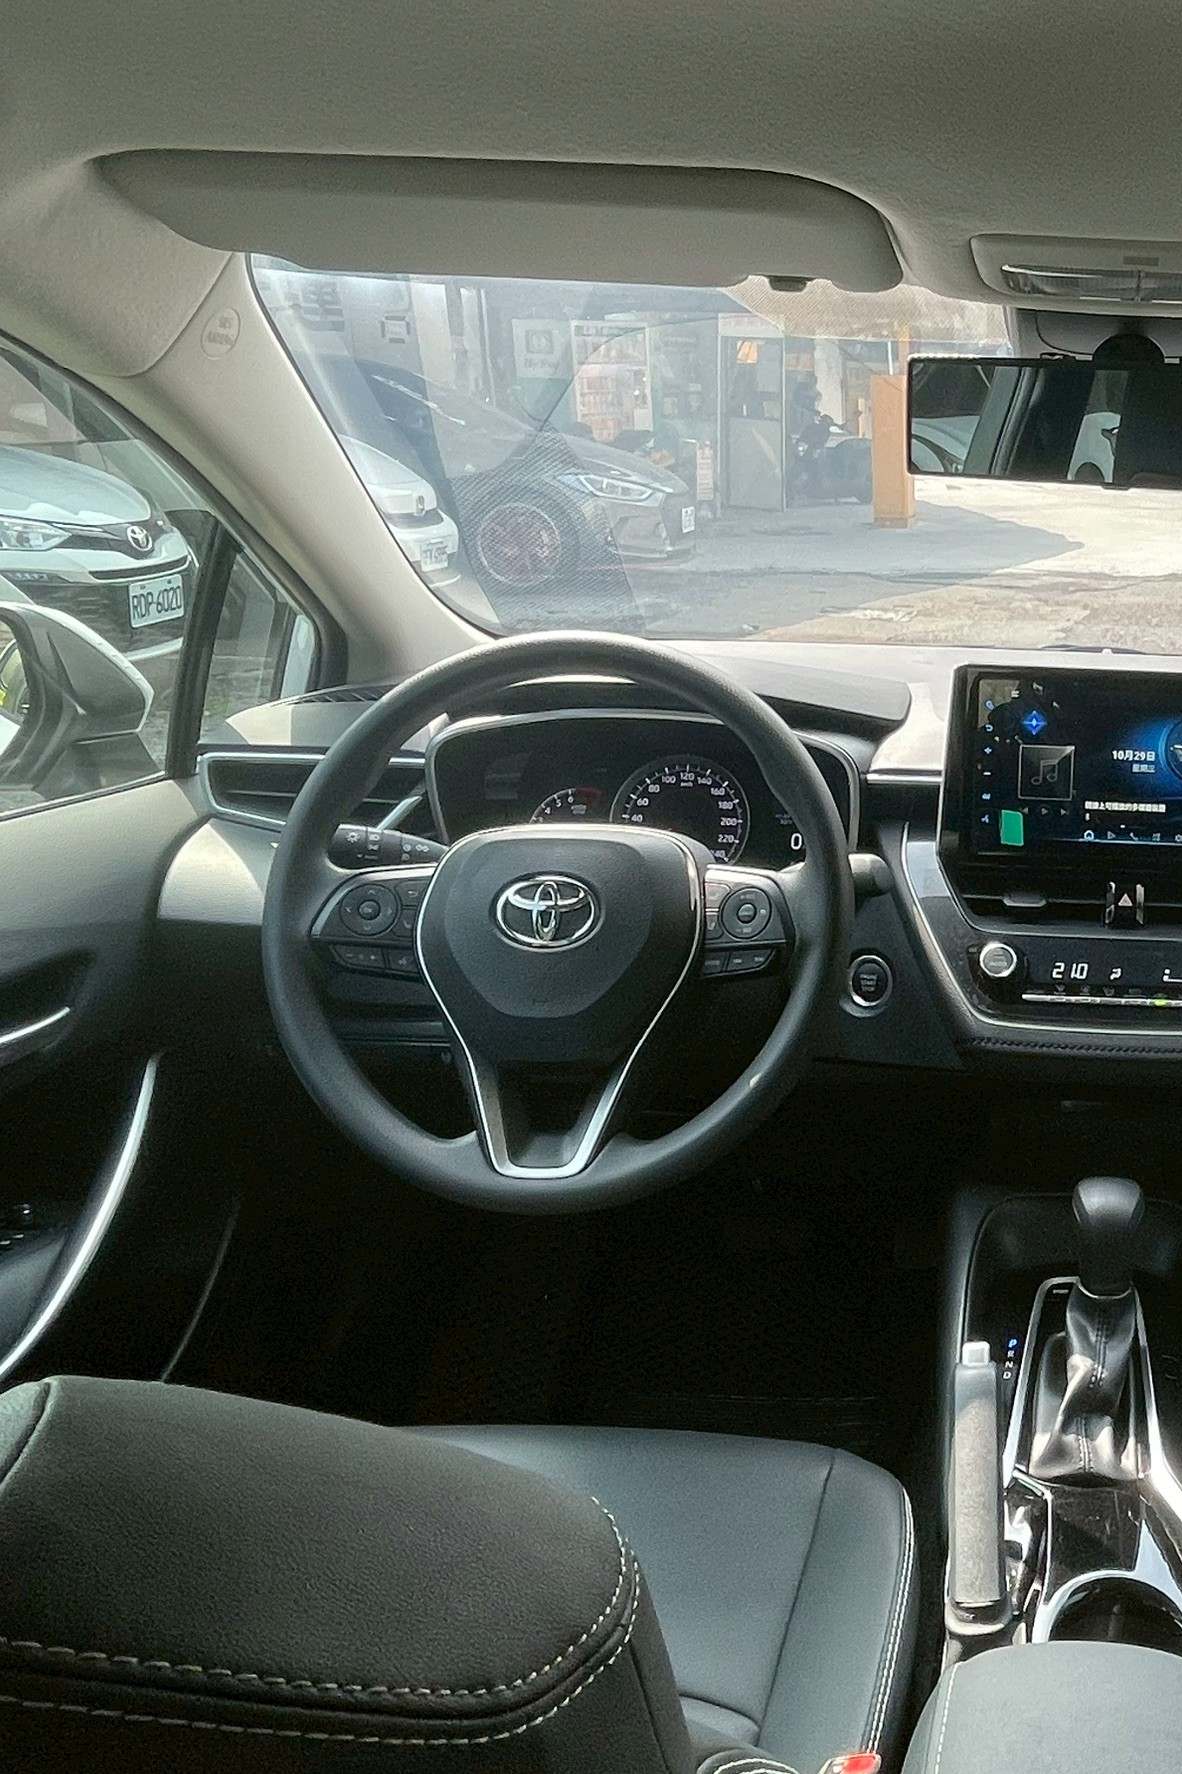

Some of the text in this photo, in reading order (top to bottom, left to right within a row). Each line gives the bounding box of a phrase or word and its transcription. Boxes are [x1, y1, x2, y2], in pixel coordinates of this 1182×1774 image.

[131, 586, 182, 619] RDP-6020
[1112, 750, 1156, 762] 10月29日
[662, 775, 676, 784] 100
[680, 772, 695, 780] 120
[697, 776, 712, 785] 140
[648, 784, 660, 793] 80
[711, 787, 725, 796] 160
[637, 797, 649, 806] 60
[718, 801, 733, 810] 180
[631, 814, 643, 822] 40
[720, 817, 737, 826] 200
[717, 834, 735, 843] 220
[791, 833, 802, 850] 0
[1008, 1339, 1017, 1348] P
[1003, 1371, 1011, 1379] D
